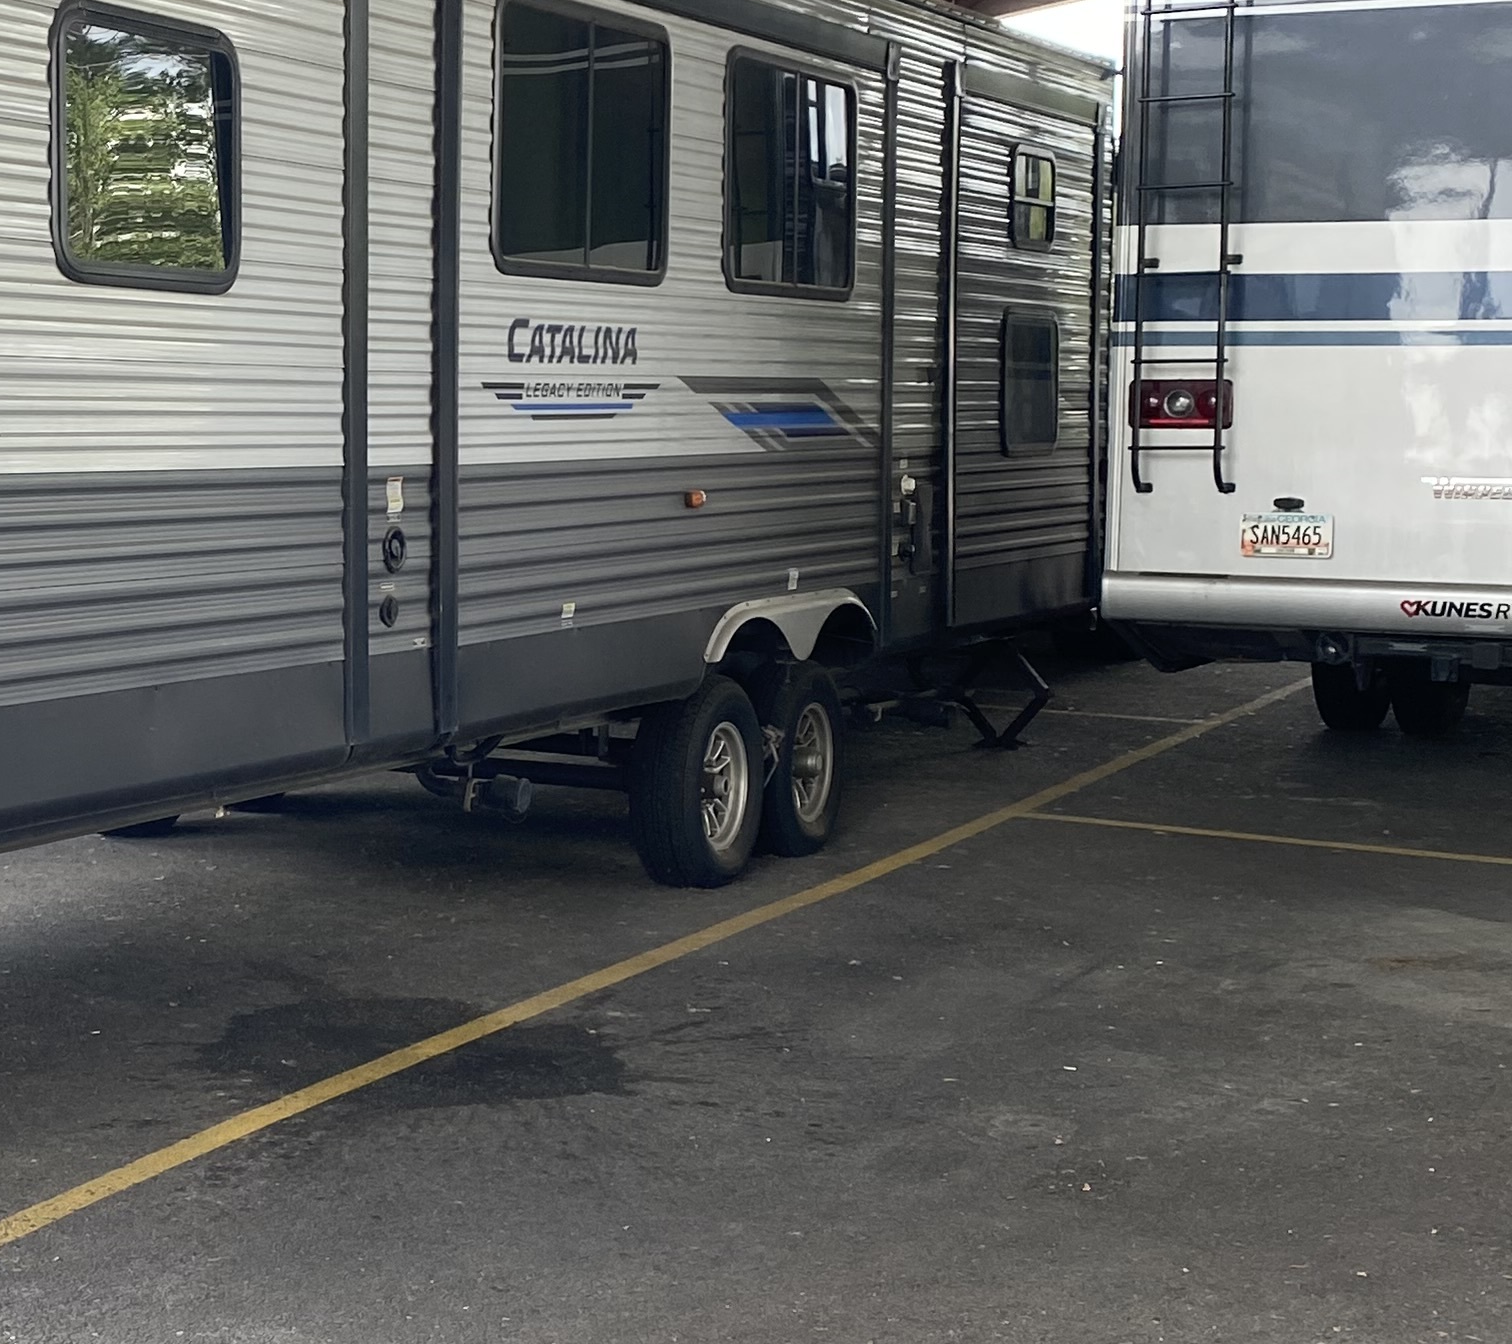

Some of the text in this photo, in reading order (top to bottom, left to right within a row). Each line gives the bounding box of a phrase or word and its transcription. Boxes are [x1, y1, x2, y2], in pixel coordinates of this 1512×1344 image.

[507, 318, 638, 365] CATALINA
[525, 383, 622, 398] LEGACY EDITION
[1276, 515, 1327, 524] GEORGIA
[1250, 524, 1322, 545] SAN5465
[1414, 600, 1494, 619] KUNES
